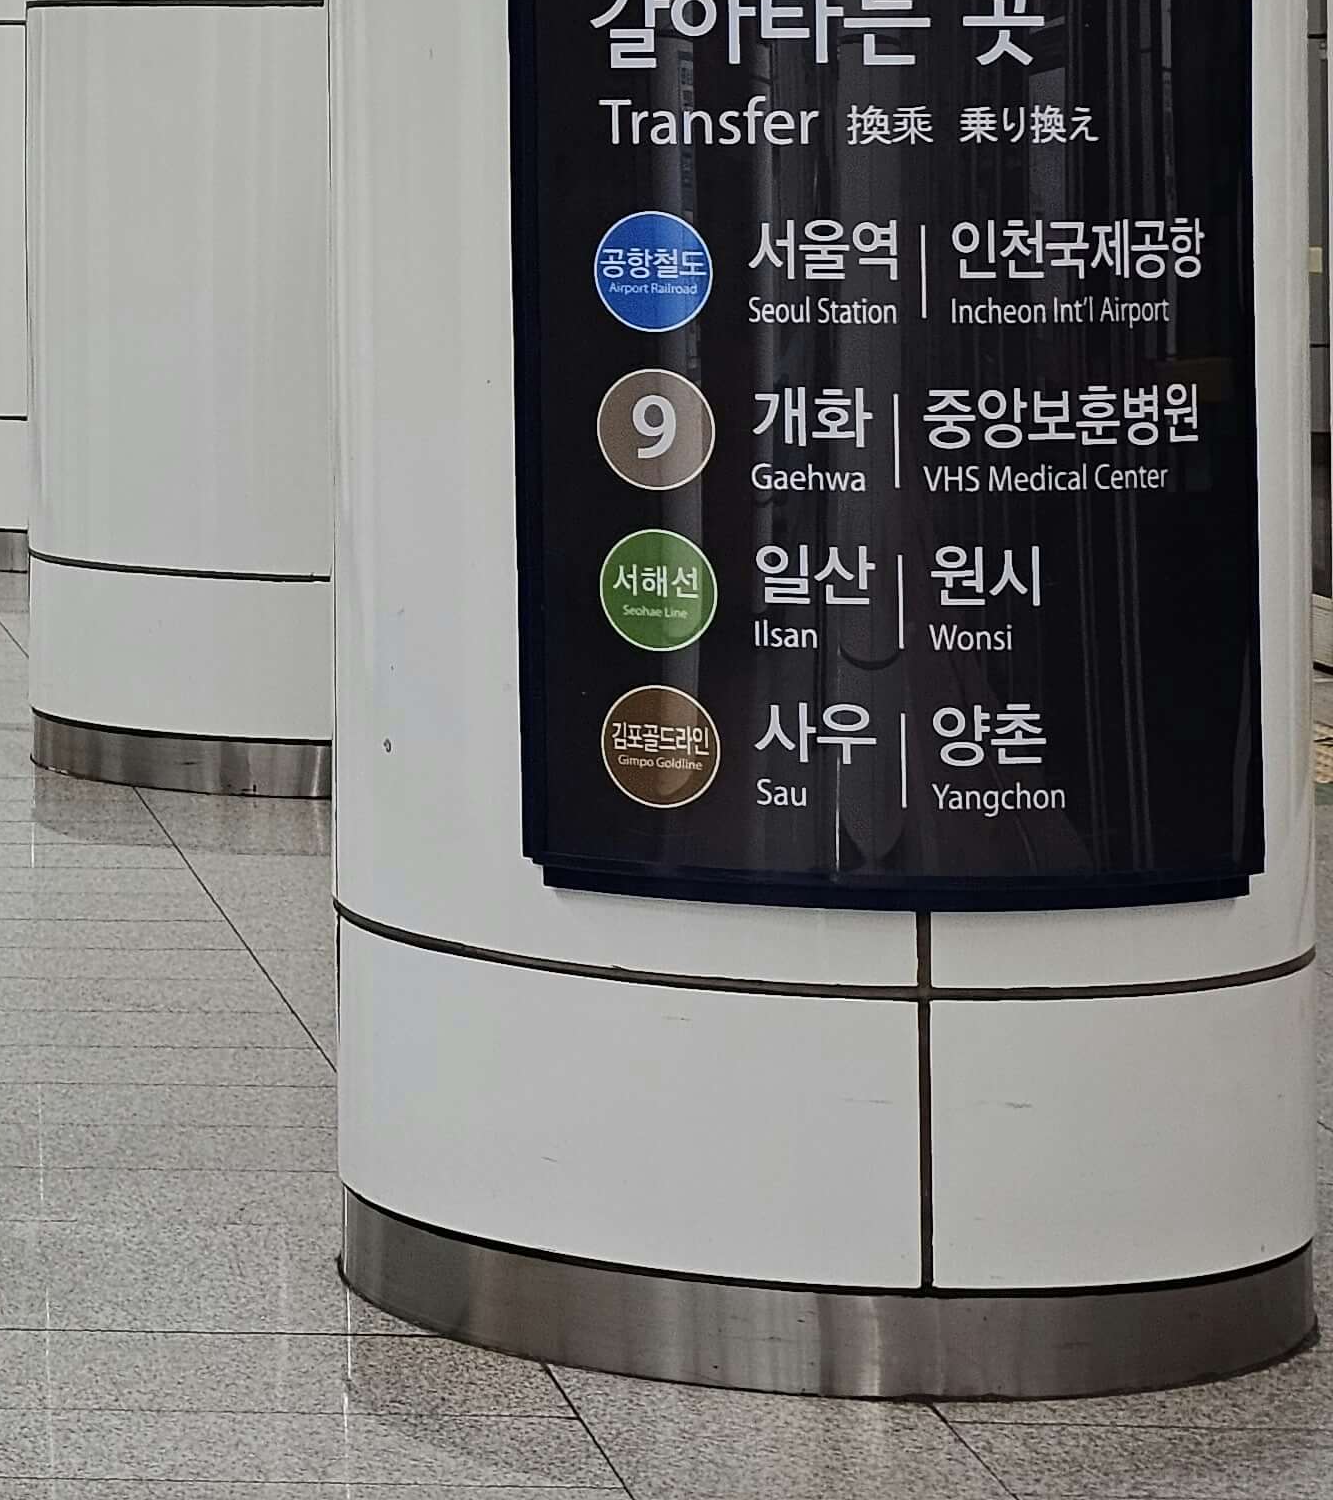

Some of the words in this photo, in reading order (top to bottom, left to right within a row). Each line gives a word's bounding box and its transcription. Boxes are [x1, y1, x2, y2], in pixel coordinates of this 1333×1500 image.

[597, 94, 821, 147] Transfer
[957, 103, 1101, 146] 乗り換え
[600, 248, 708, 280] 공항철도
[748, 219, 899, 281] 서울역
[950, 217, 1206, 280] 인천국제공항
[608, 283, 650, 295] Airport
[651, 283, 699, 296] Railroad
[748, 296, 811, 324] Seoul
[818, 298, 898, 325] Station
[951, 296, 1047, 325] Incheon
[1099, 296, 1170, 329] Airport
[632, 394, 678, 460] 9
[752, 386, 874, 449] 개화
[922, 383, 1199, 450] 중앙보훈병원
[750, 462, 867, 492] Gaehwa
[922, 465, 980, 493] VHS
[987, 463, 1088, 493] Medical
[1094, 463, 1169, 490] Center
[612, 563, 700, 599] 서해선
[754, 544, 877, 605] 일산
[930, 545, 1041, 607] 원시
[622, 604, 663, 618] Seohae
[664, 606, 688, 619] Line
[753, 619, 818, 649] Ilsan
[929, 623, 1013, 651] Wonsi
[611, 721, 711, 756] 김포골드라인
[753, 702, 878, 765] 사우
[932, 703, 1048, 768] 양촌
[617, 753, 654, 770] Gimpo
[655, 756, 703, 771] Goldline
[755, 777, 808, 807] Sau
[931, 781, 1067, 819] Yangchon
